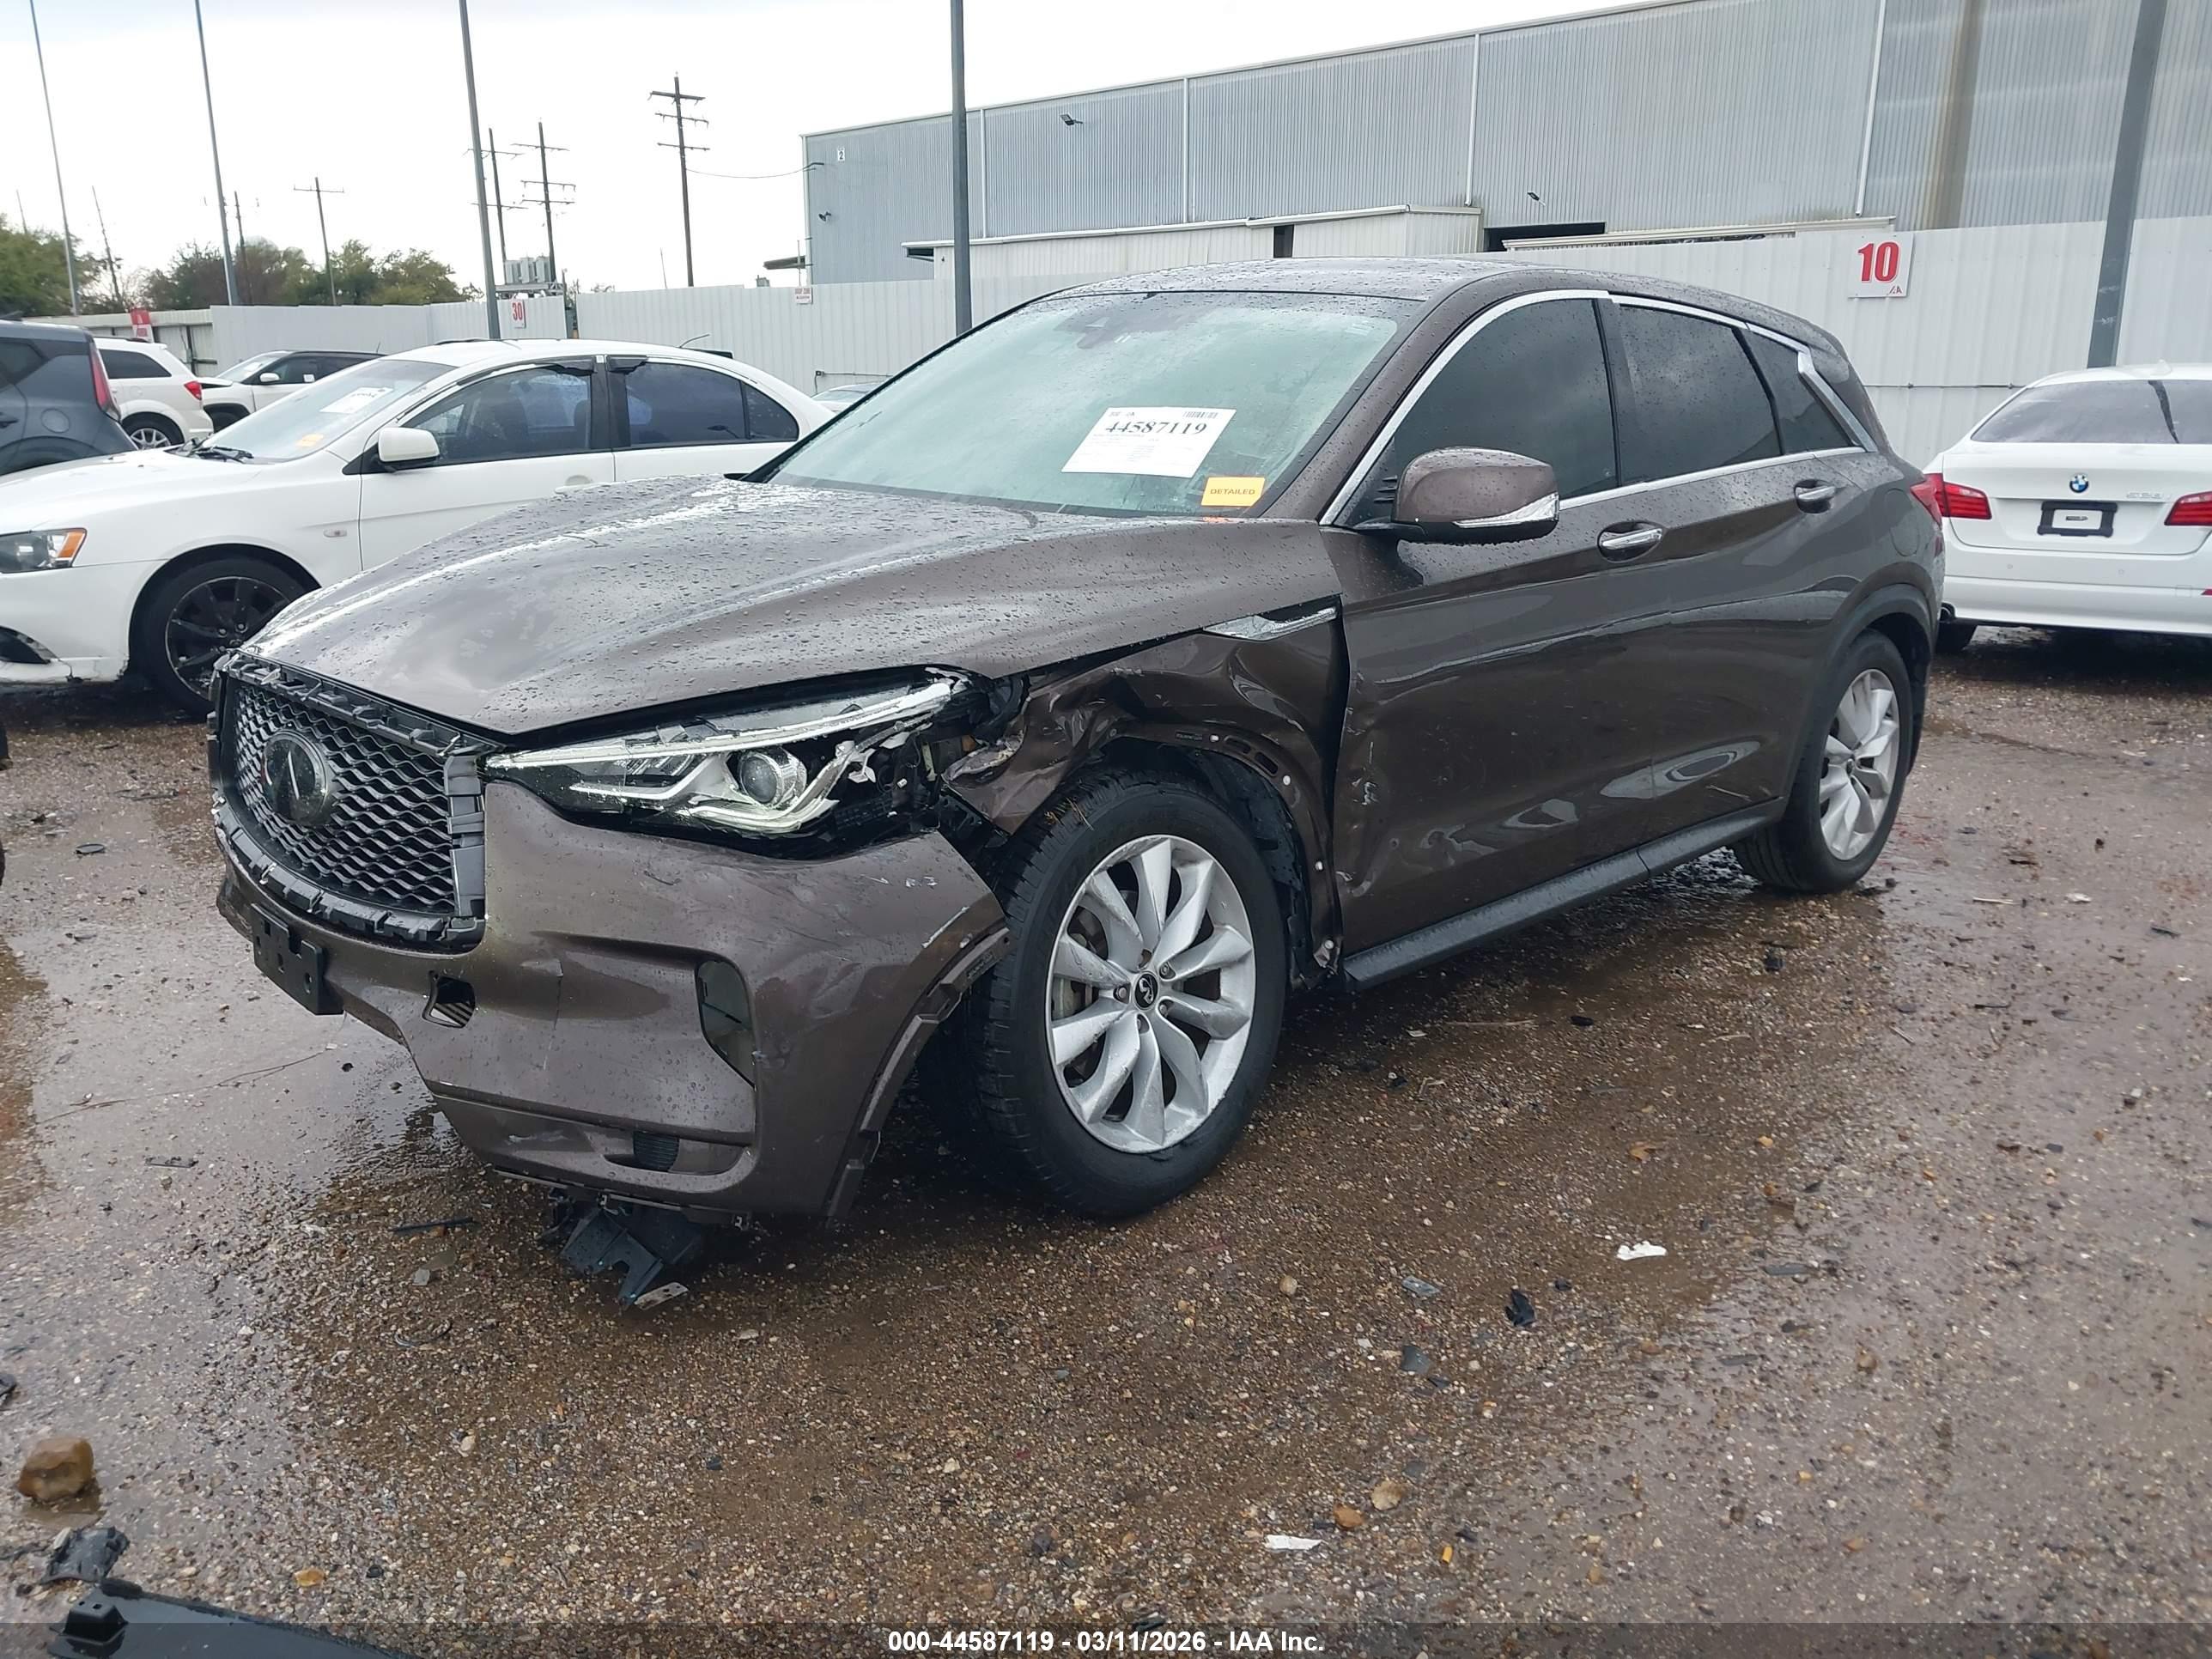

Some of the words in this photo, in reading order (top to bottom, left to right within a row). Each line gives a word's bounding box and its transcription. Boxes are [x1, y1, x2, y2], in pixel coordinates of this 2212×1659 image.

[1857, 241, 1899, 282] 10
[512, 302, 523, 320] 30
[1105, 421, 1207, 434] 44587119
